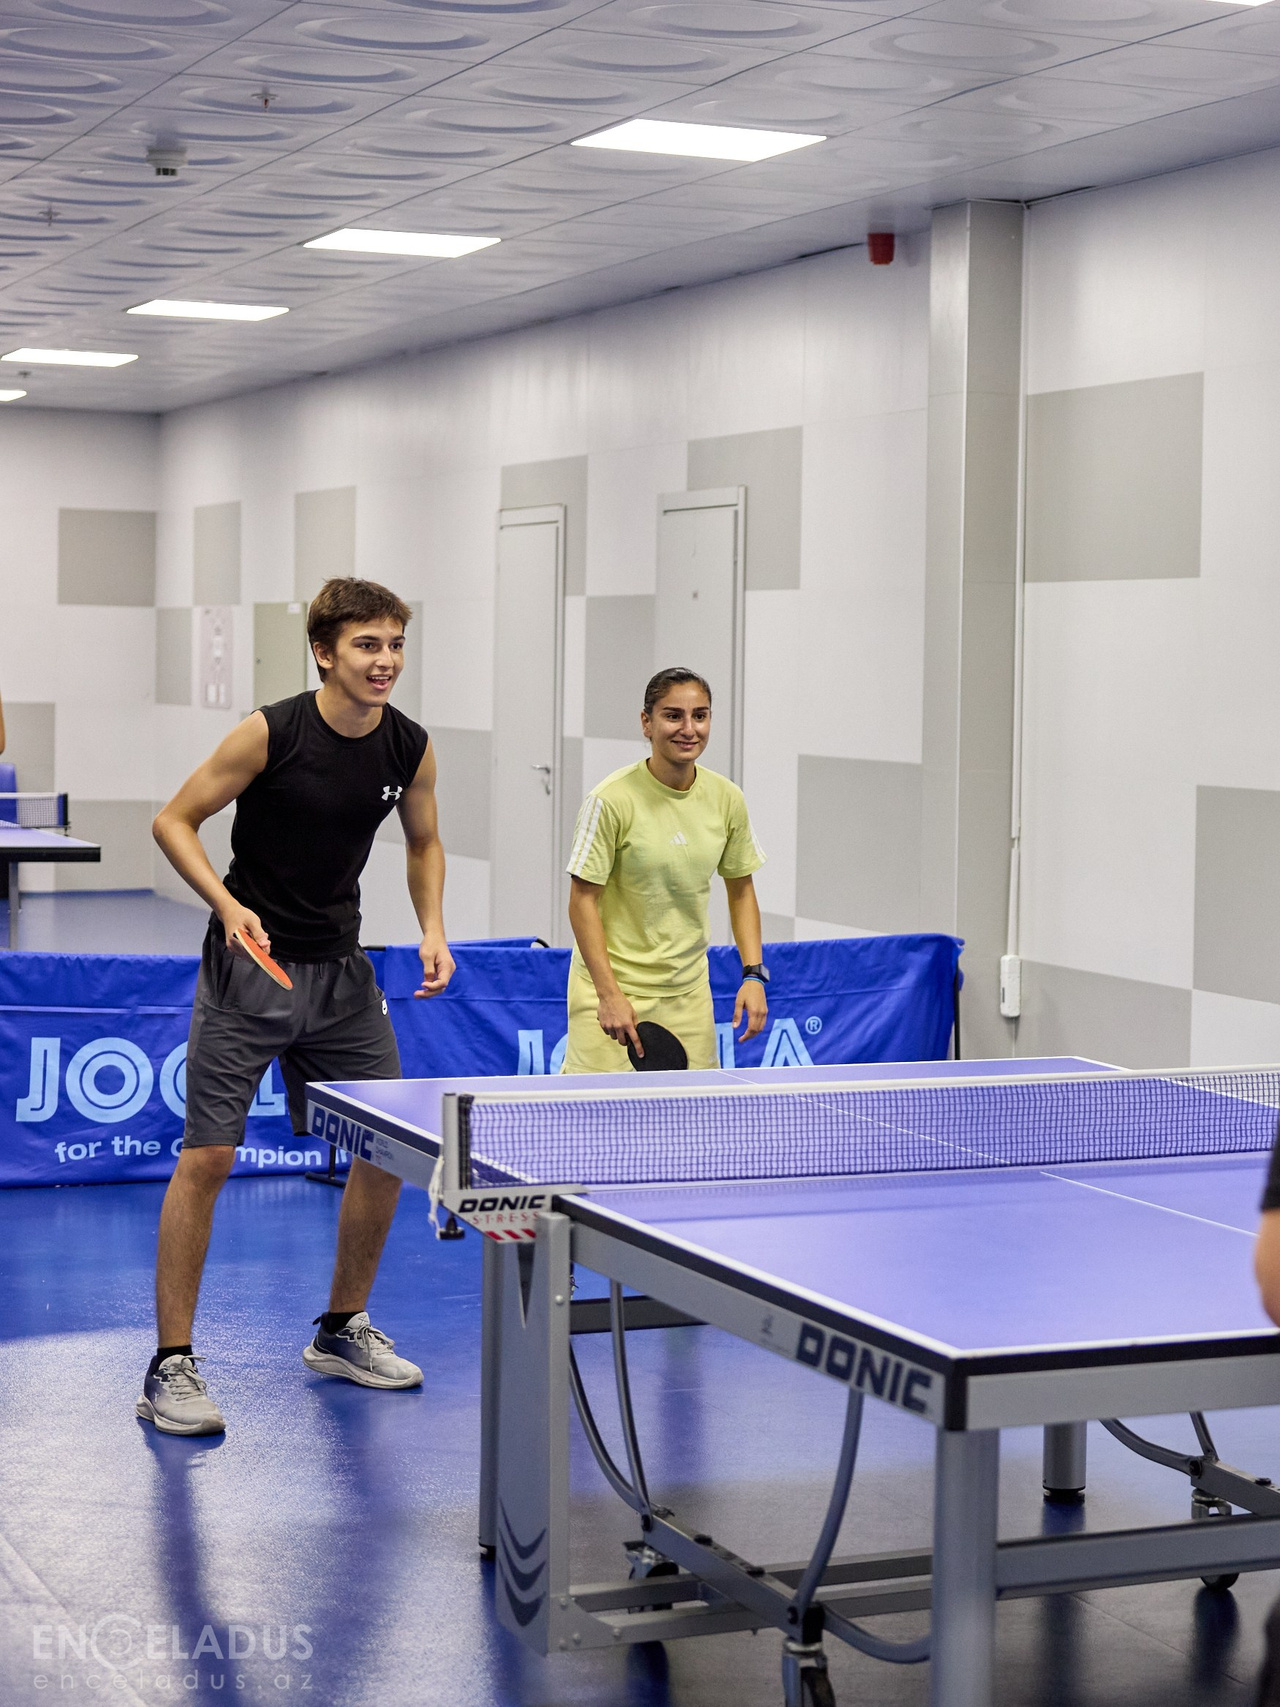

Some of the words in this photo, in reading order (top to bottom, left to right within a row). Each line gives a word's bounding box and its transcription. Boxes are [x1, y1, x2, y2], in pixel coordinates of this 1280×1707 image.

[55, 1140, 102, 1163] for
[111, 1135, 161, 1157] the
[311, 1105, 375, 1162] DONIC
[458, 1194, 547, 1214] DONIC
[795, 1321, 933, 1413] DONIC
